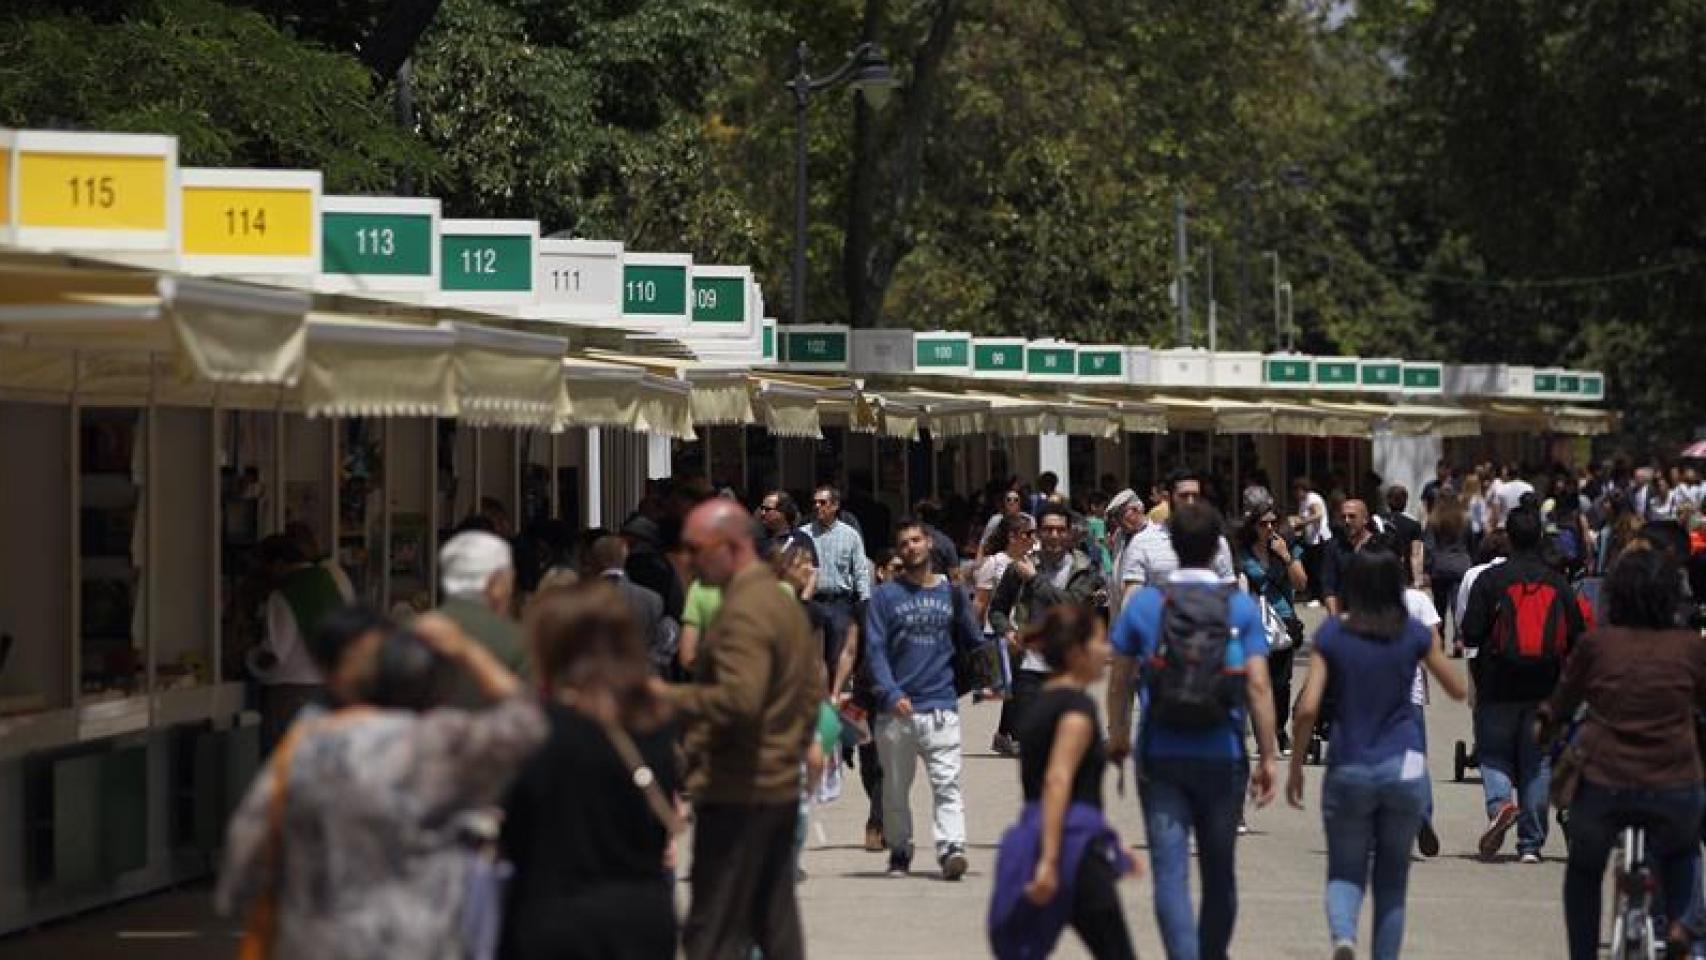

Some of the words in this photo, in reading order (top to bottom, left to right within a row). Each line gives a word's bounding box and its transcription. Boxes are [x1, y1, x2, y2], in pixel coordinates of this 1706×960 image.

[66, 177, 115, 208] 115
[225, 208, 267, 236] 114
[356, 228, 395, 256] 113
[460, 248, 497, 273] 112
[552, 269, 580, 291] 111
[626, 280, 657, 302] 110
